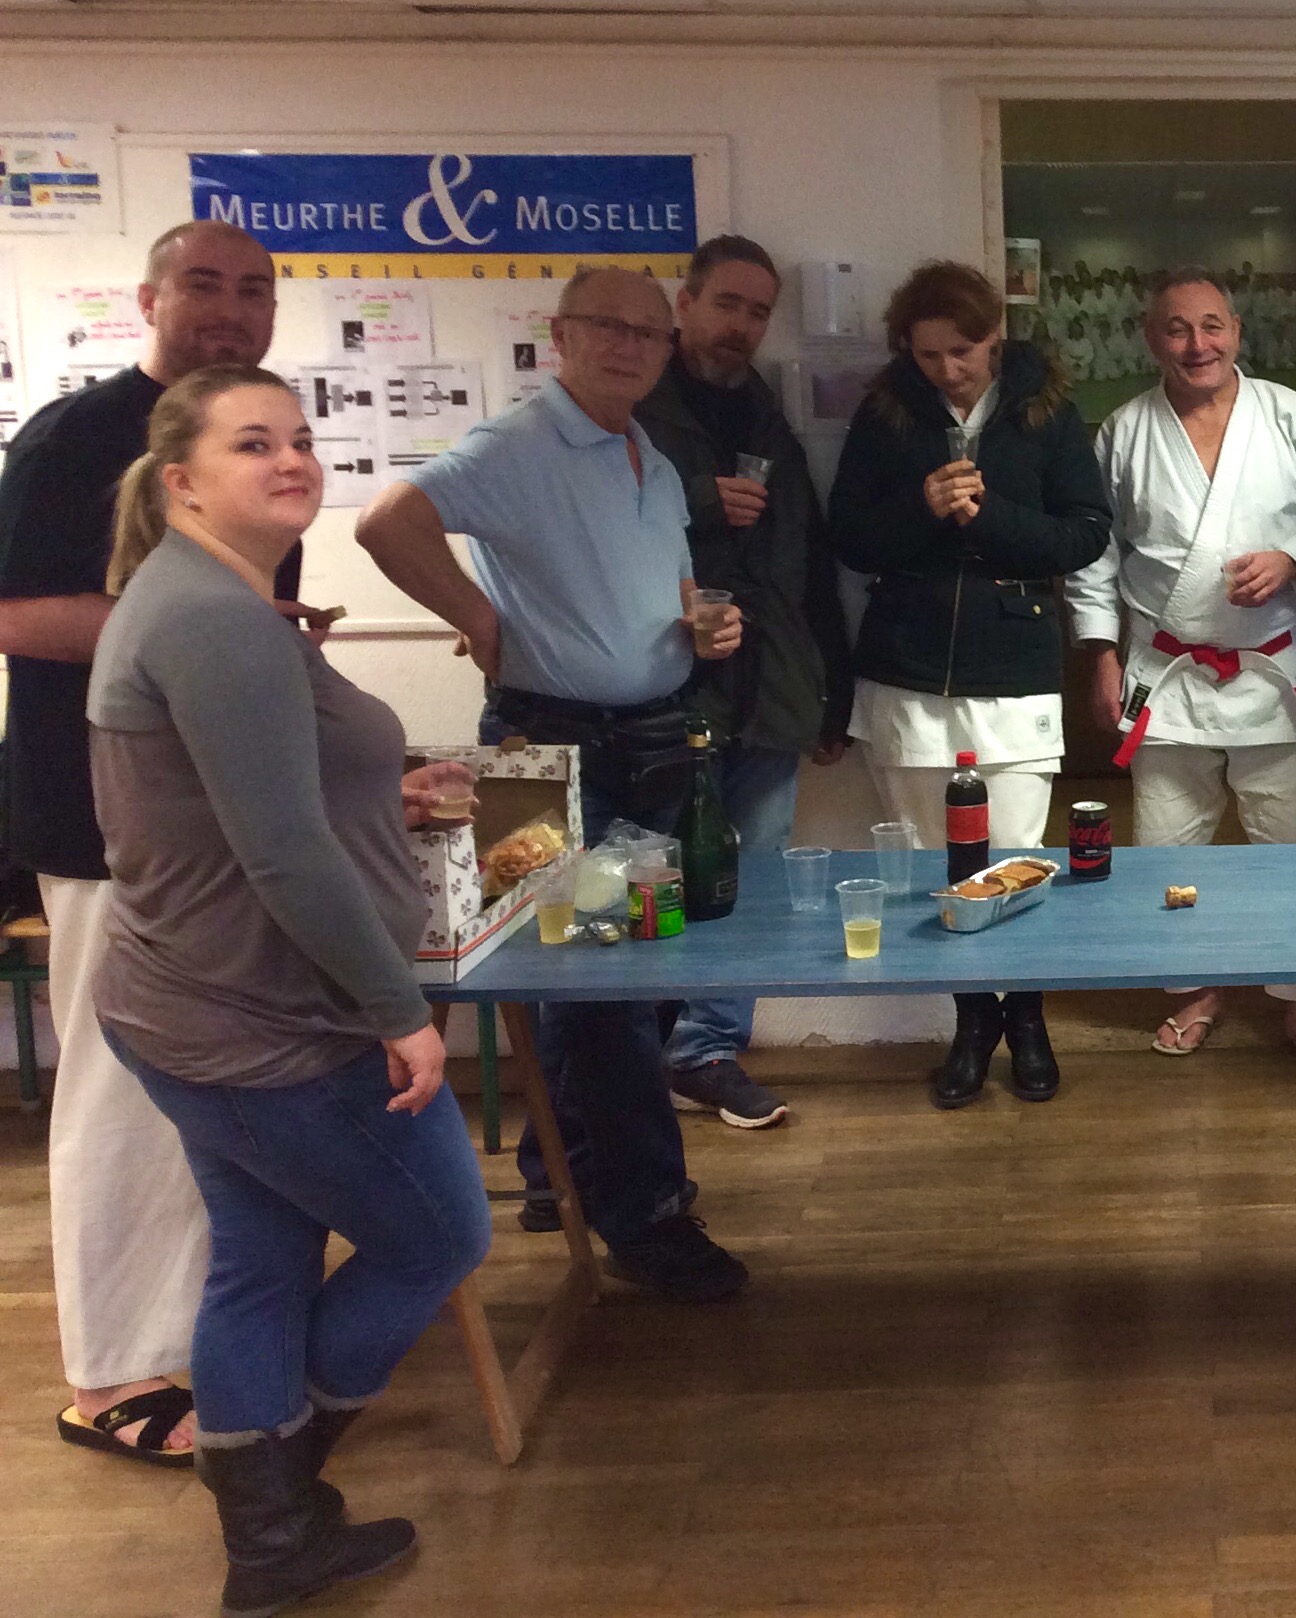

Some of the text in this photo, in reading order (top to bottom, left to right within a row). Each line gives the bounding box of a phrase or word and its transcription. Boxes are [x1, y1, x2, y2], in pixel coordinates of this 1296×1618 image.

[208, 153, 683, 246] MEURTHE & MOSELLE
[281, 264, 423, 279] NSEIL
